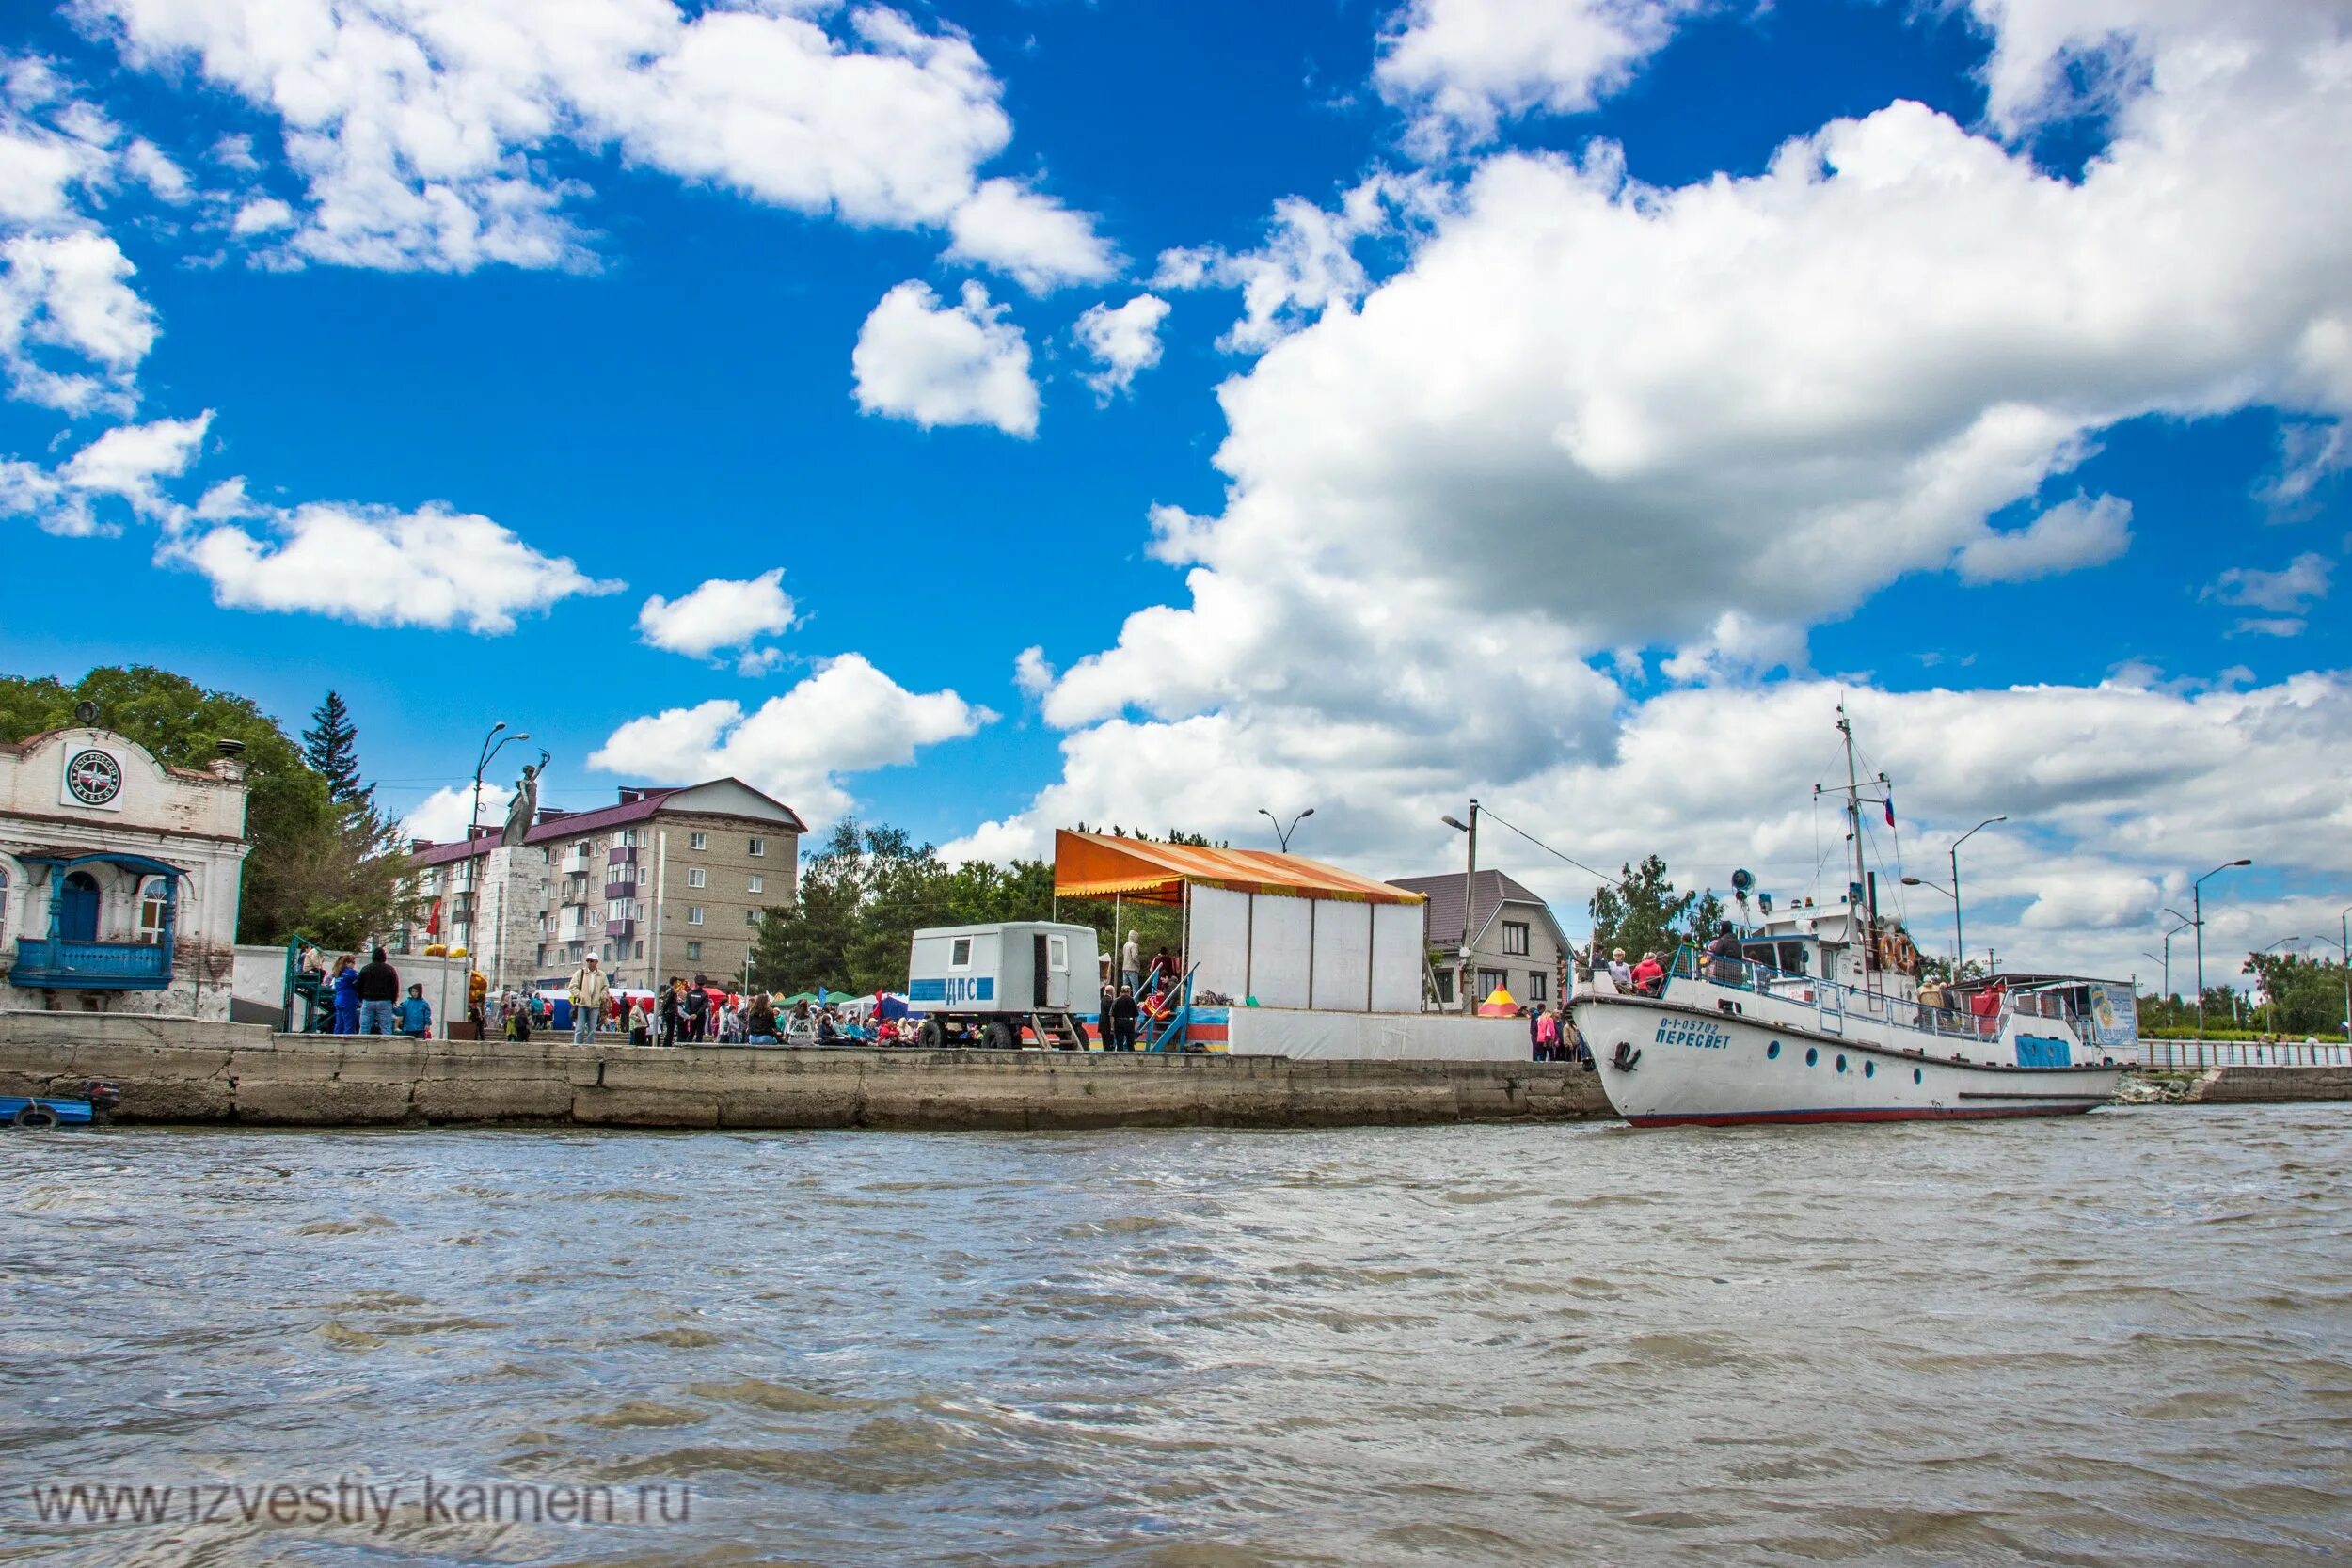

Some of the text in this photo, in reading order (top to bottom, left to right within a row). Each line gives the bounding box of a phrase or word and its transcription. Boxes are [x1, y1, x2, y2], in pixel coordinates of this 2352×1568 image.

[74, 754, 117, 776] МЧС РОССИИ
[73, 779, 117, 800] EMERCOM
[946, 977, 976, 1006] ДПС
[1656, 1029, 1730, 1049] ПЕРЕСВЕТ
